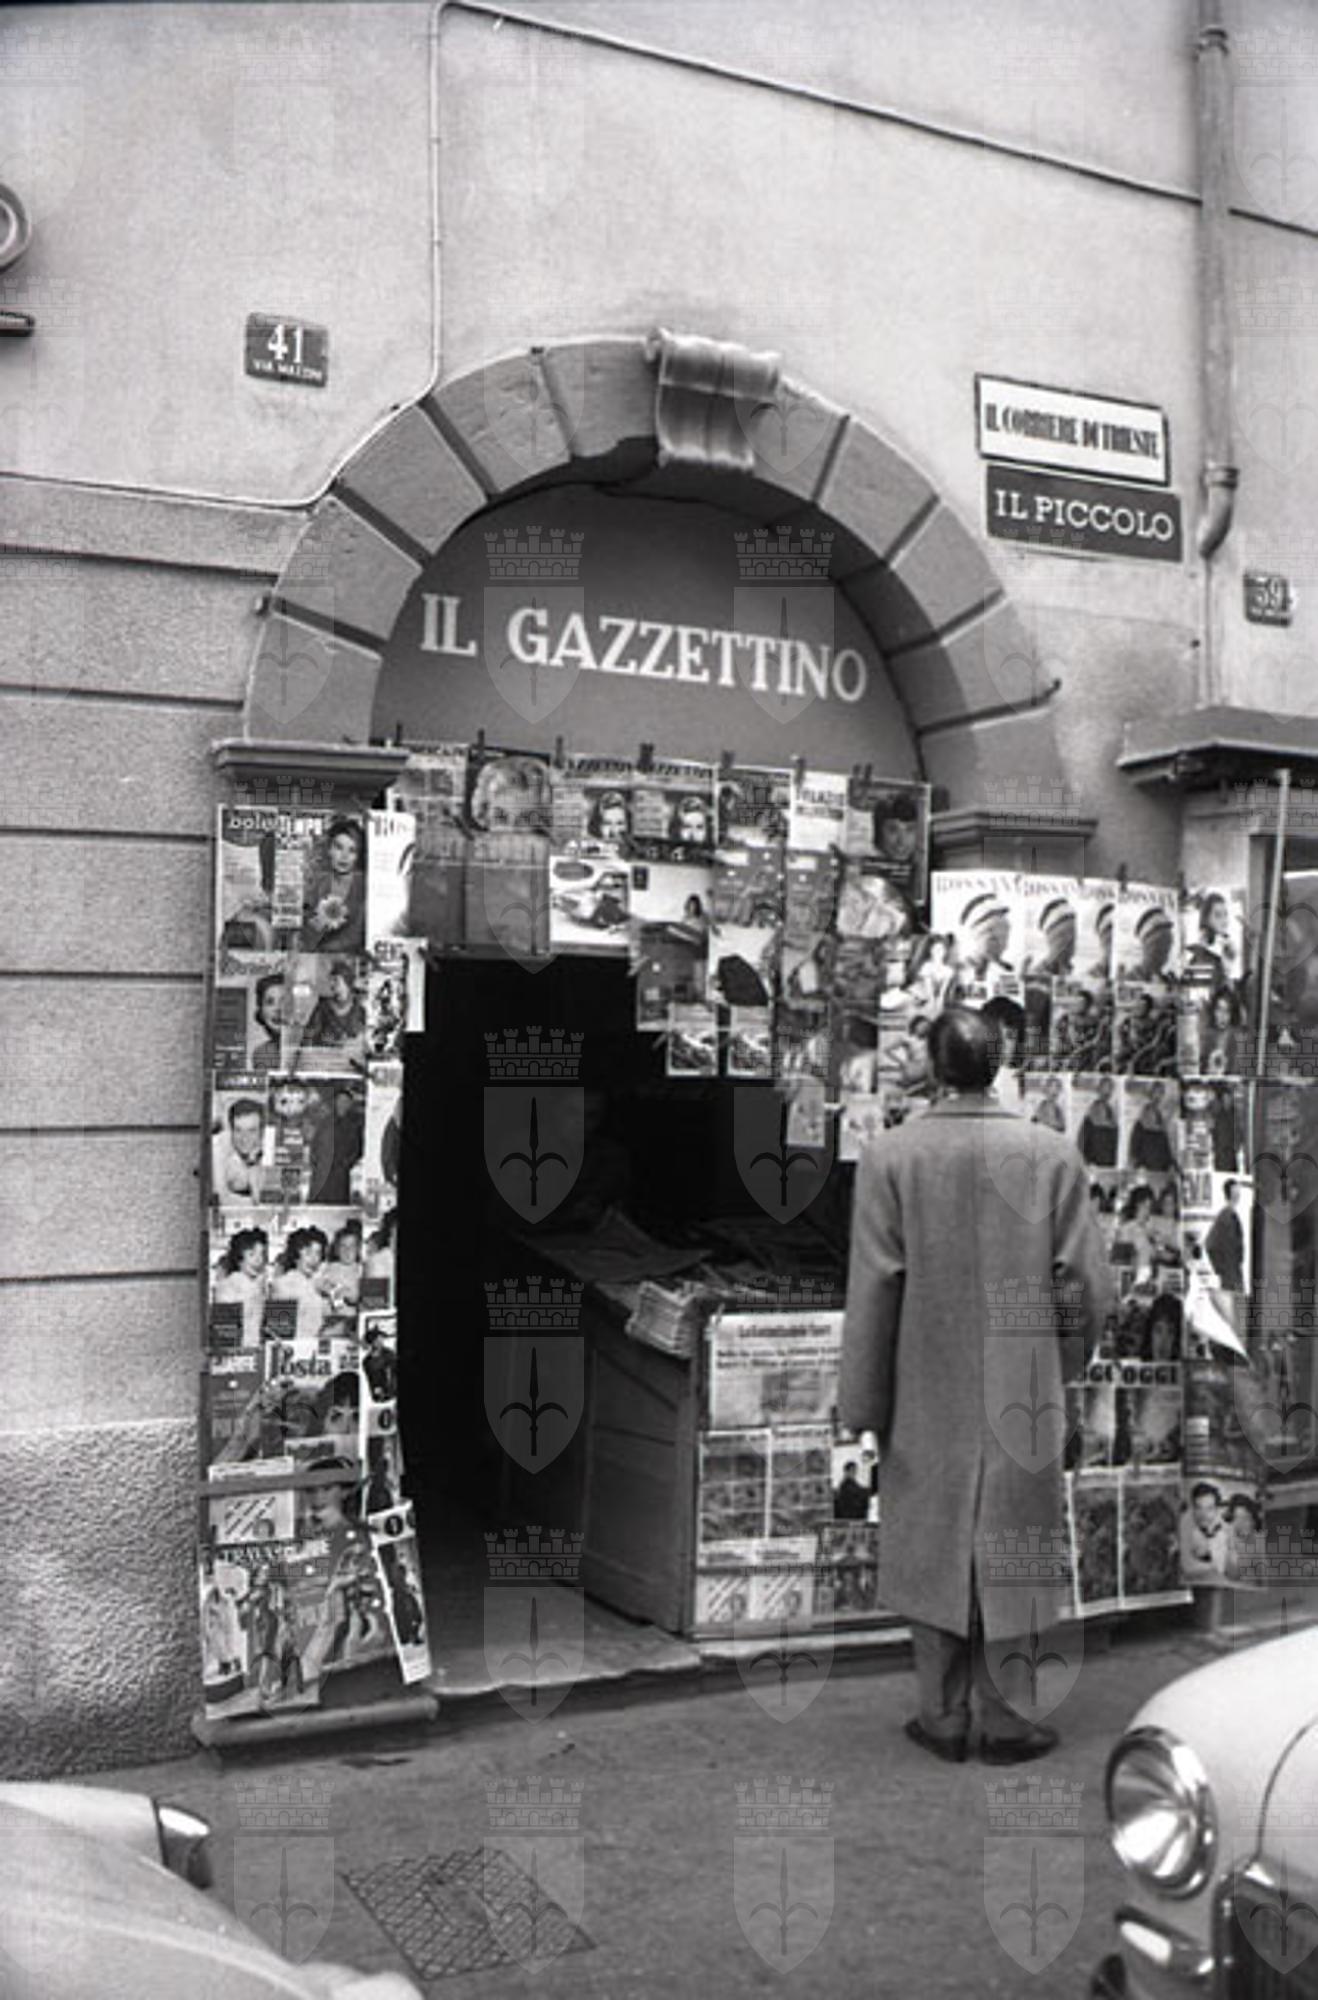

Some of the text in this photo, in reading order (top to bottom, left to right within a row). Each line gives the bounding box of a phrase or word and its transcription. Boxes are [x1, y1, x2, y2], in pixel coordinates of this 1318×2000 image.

[268, 324, 304, 364] 41
[985, 402, 1000, 432] IL
[1002, 405, 1078, 445] CORRIERE
[1083, 419, 1099, 449] DI
[994, 489, 1175, 542] IL PICCOLO
[419, 591, 869, 704] IL GAZZETTINO
[1122, 1366, 1179, 1385] OGGI
